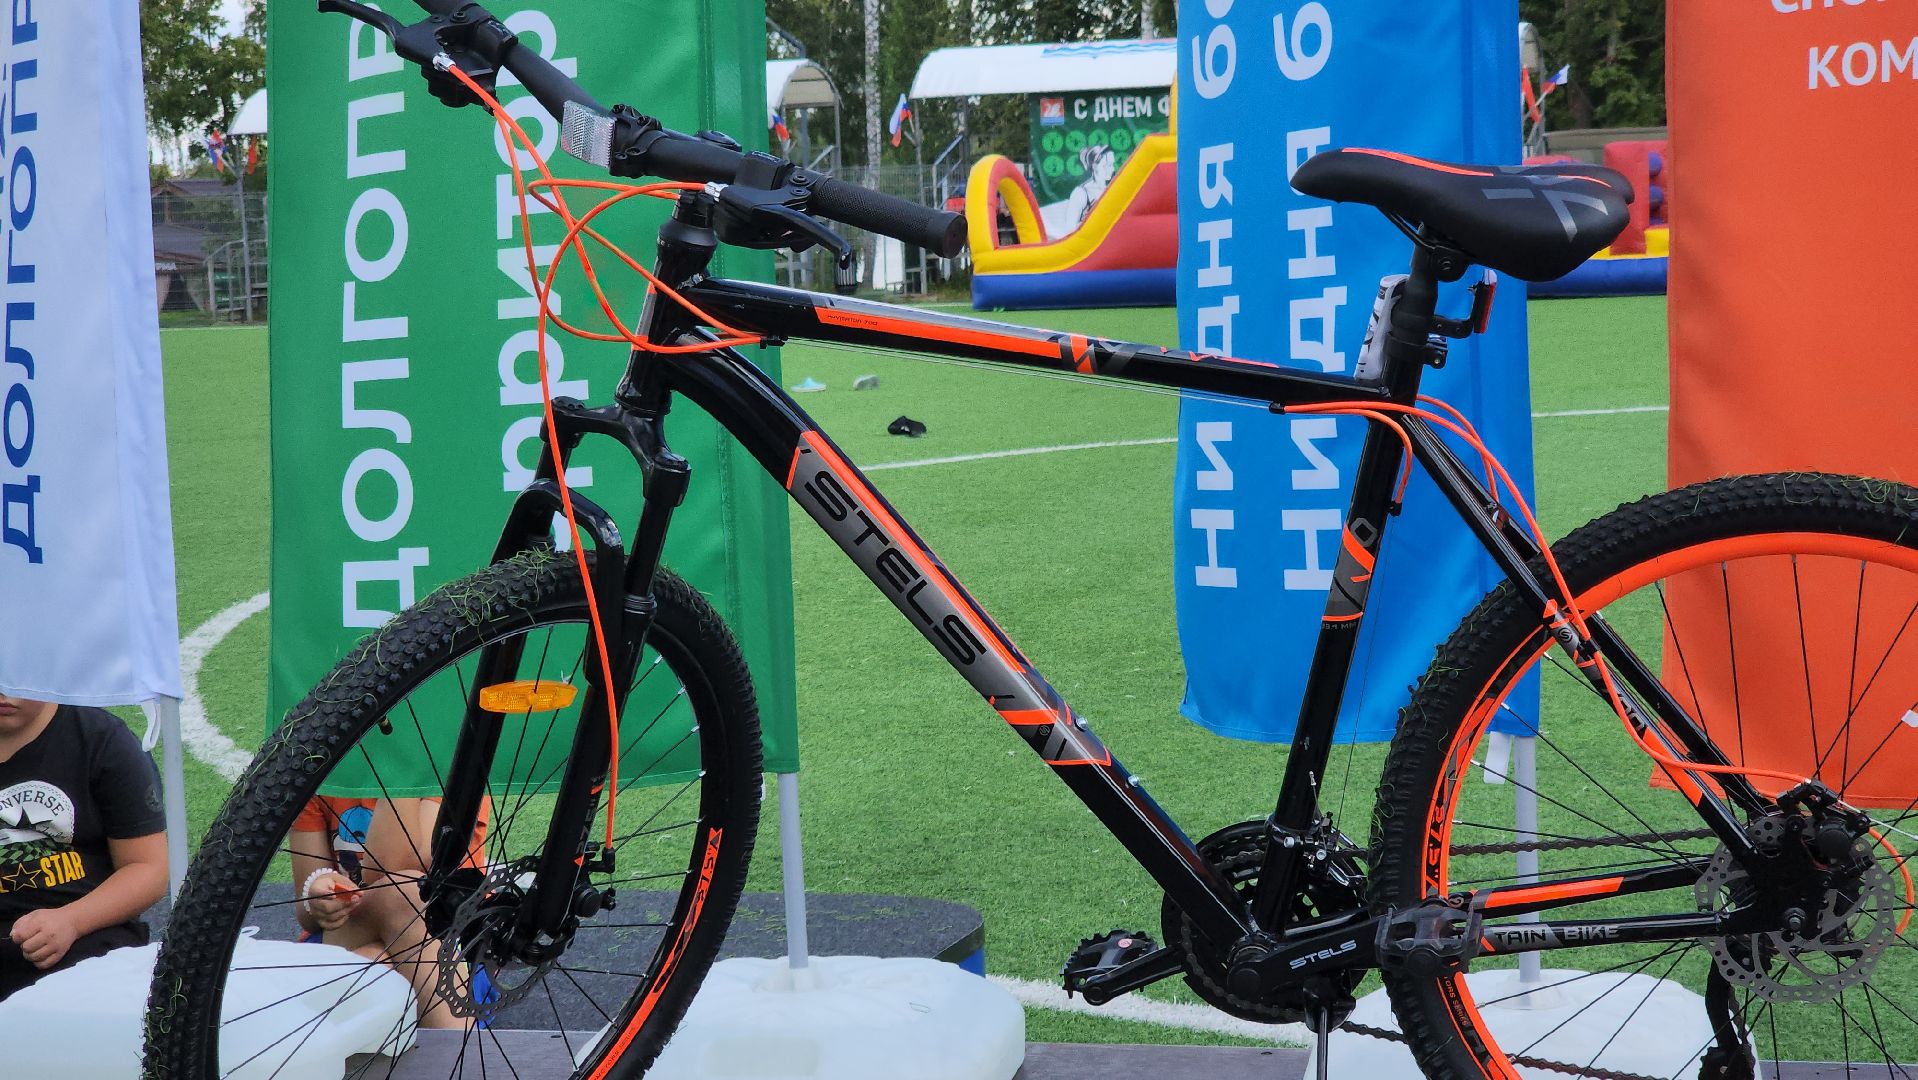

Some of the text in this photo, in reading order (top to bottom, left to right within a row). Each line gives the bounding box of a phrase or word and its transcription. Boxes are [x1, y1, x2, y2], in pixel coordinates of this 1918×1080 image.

[1192, 0, 1237, 99] б
[1073, 98, 1088, 120] С
[1093, 95, 1153, 122] ДНЕМ
[493, 9, 594, 551] рритор
[804, 470, 987, 665] STELS
[0, 789, 65, 817] NVERSE
[40, 850, 86, 888] STAR
[1494, 925, 1620, 946] TAIN BIKE
[1289, 939, 1357, 970] STELS
